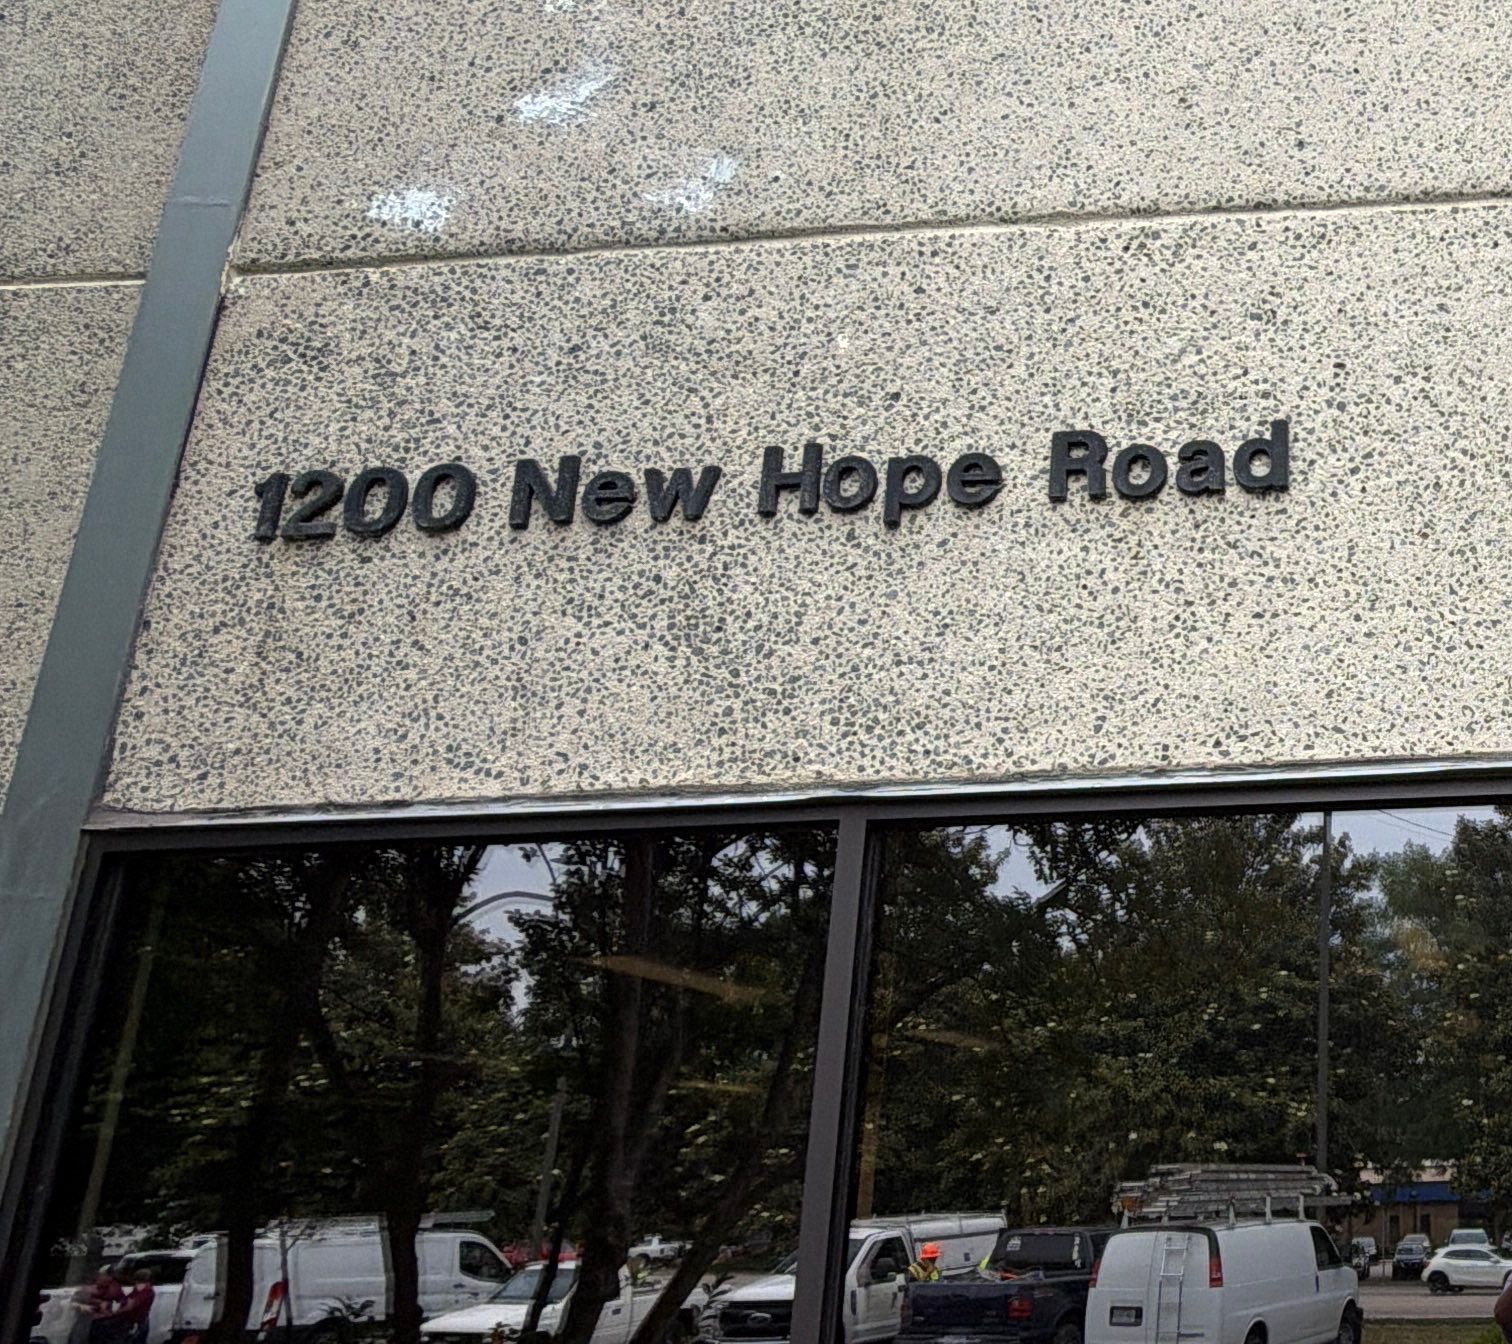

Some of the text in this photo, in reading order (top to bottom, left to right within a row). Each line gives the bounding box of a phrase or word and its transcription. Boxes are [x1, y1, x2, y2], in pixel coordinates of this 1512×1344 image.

[253, 418, 1291, 543] 1200 New Hope Road
